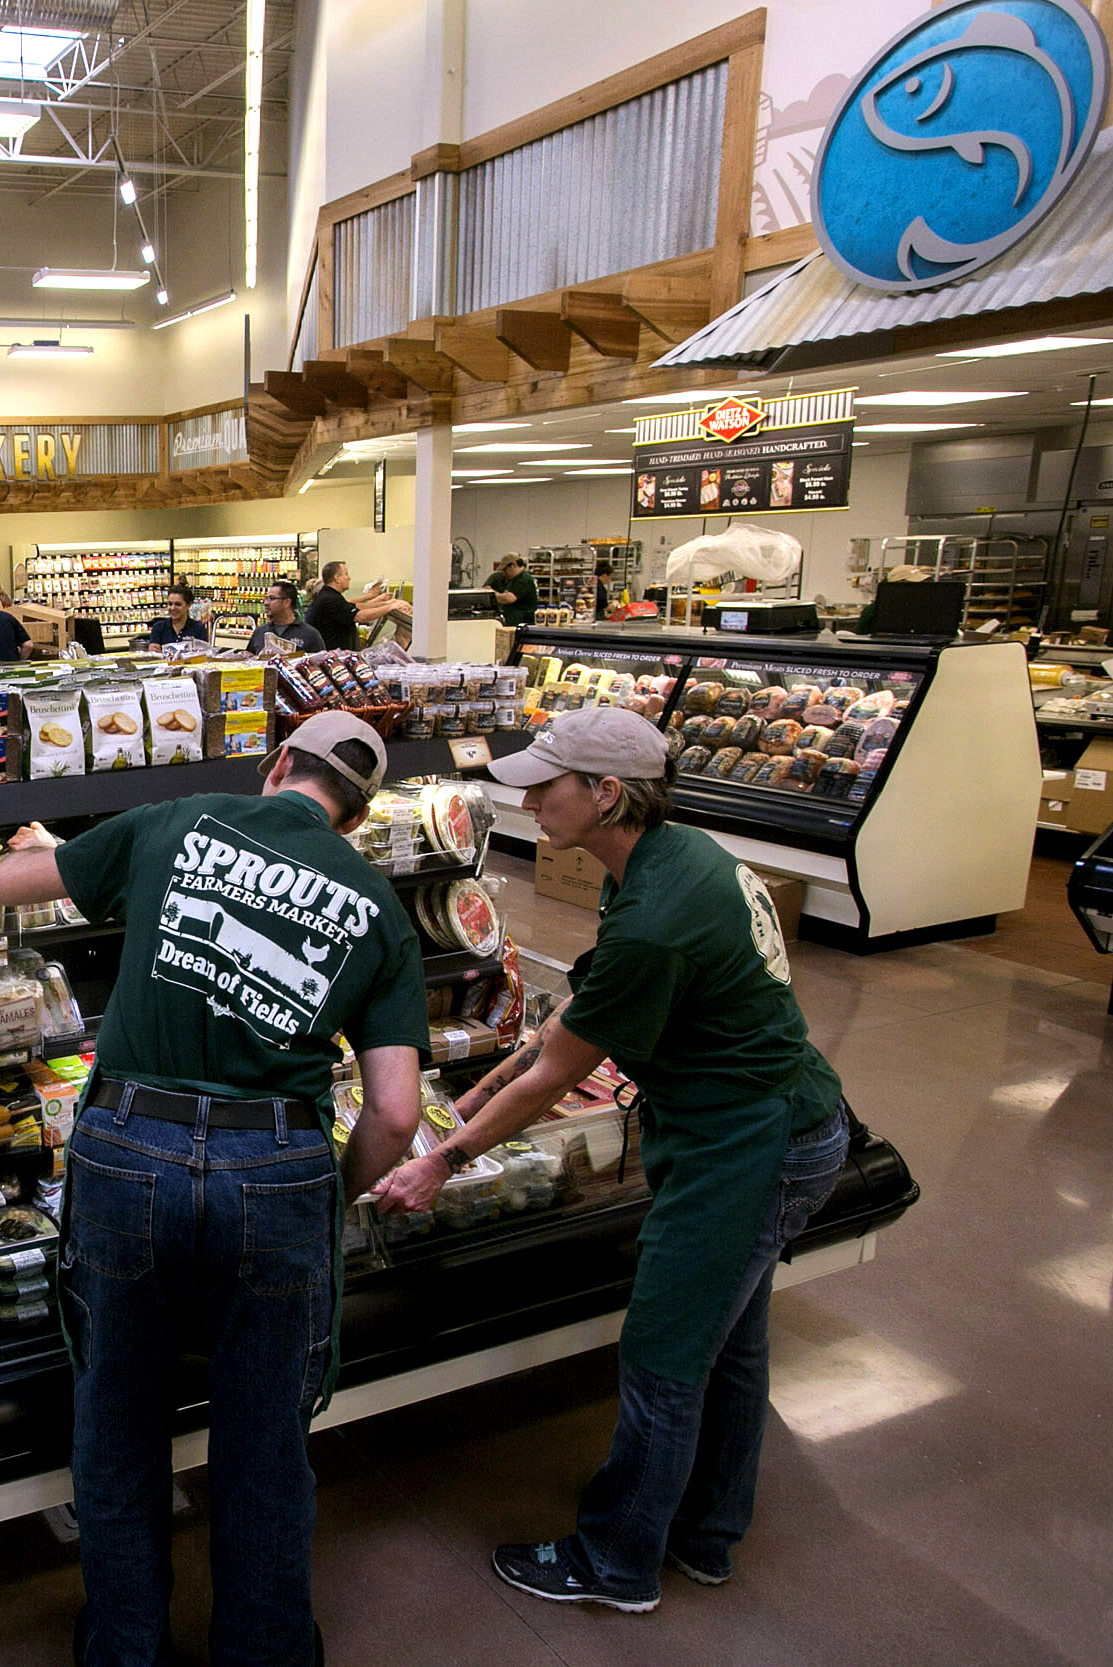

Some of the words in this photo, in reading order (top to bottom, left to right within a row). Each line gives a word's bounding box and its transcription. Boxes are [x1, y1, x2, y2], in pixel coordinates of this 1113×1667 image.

[709, 415, 750, 431] WATSON
[715, 407, 742, 420] DIETZ
[742, 407, 750, 417] &
[173, 427, 224, 457] Premium
[593, 651, 612, 659] SLICED
[785, 666, 812, 675] SLICED
[812, 668, 838, 677] FRESH
[838, 670, 850, 678] TO
[850, 671, 882, 681] ORDER
[173, 831, 380, 938] SPROUTS
[179, 872, 268, 910] FARMERS
[266, 898, 349, 945] MARKET
[217, 971, 242, 995] of
[239, 984, 300, 1035] Fields
